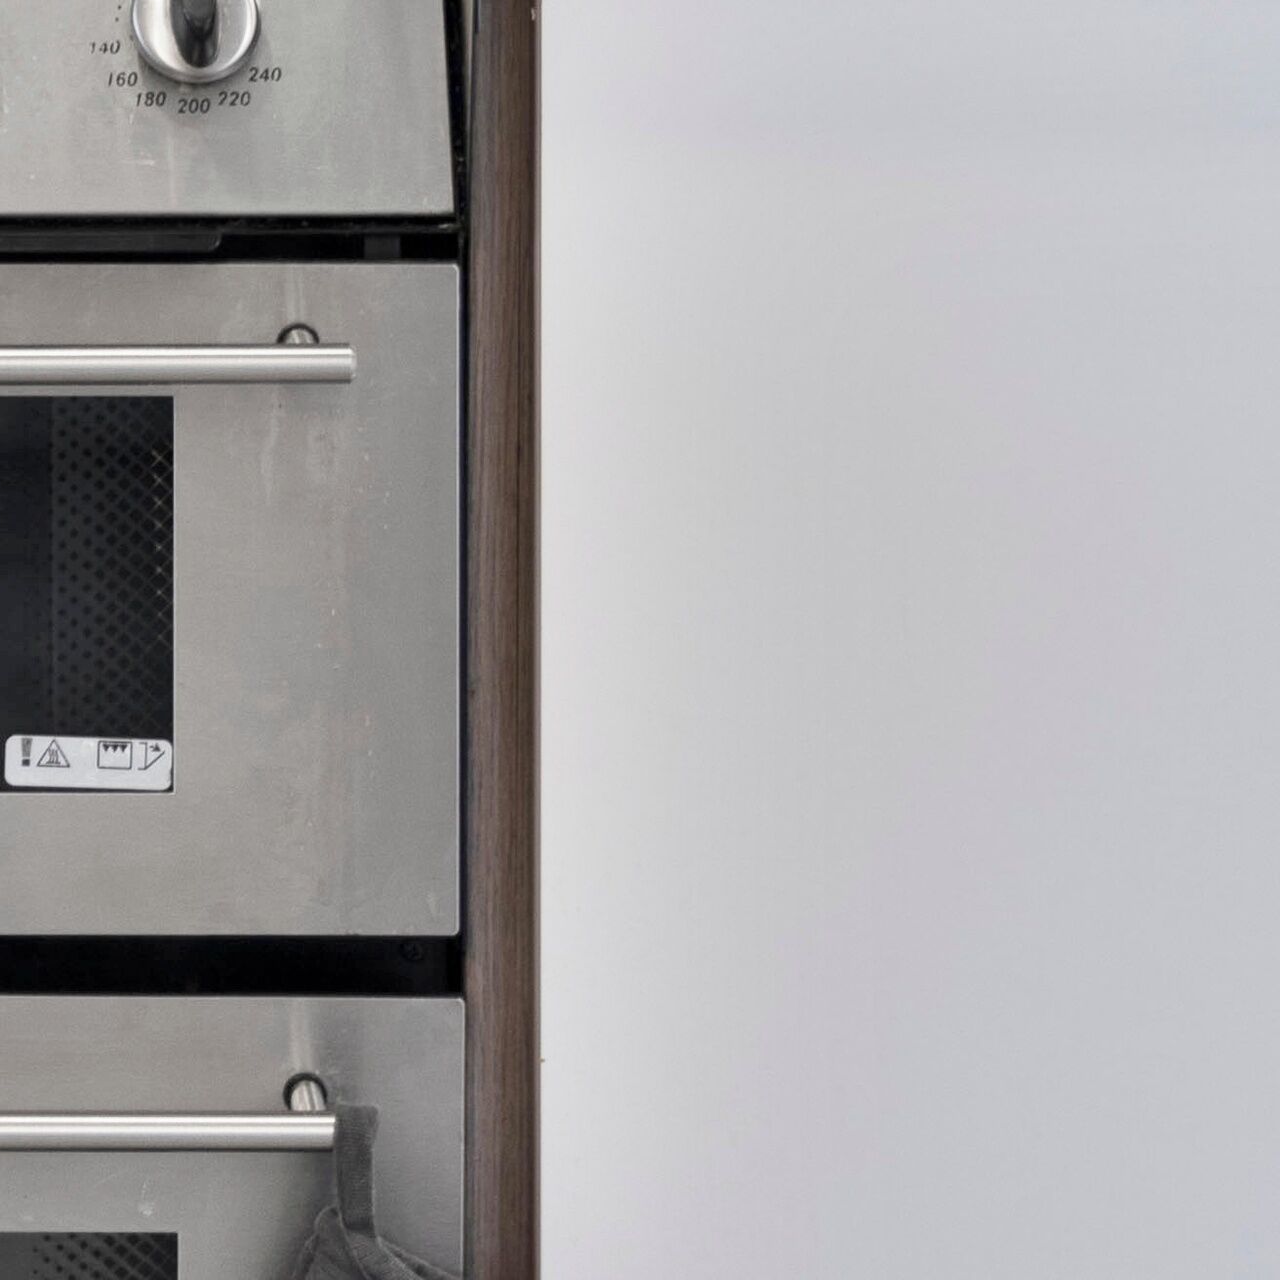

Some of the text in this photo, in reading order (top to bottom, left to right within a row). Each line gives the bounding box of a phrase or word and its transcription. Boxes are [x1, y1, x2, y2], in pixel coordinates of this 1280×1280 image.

[90, 41, 121, 55] 140
[107, 72, 138, 87] 160
[248, 67, 282, 82] 240
[136, 91, 167, 107] 180
[178, 98, 211, 114] 200
[218, 91, 251, 107] 220
